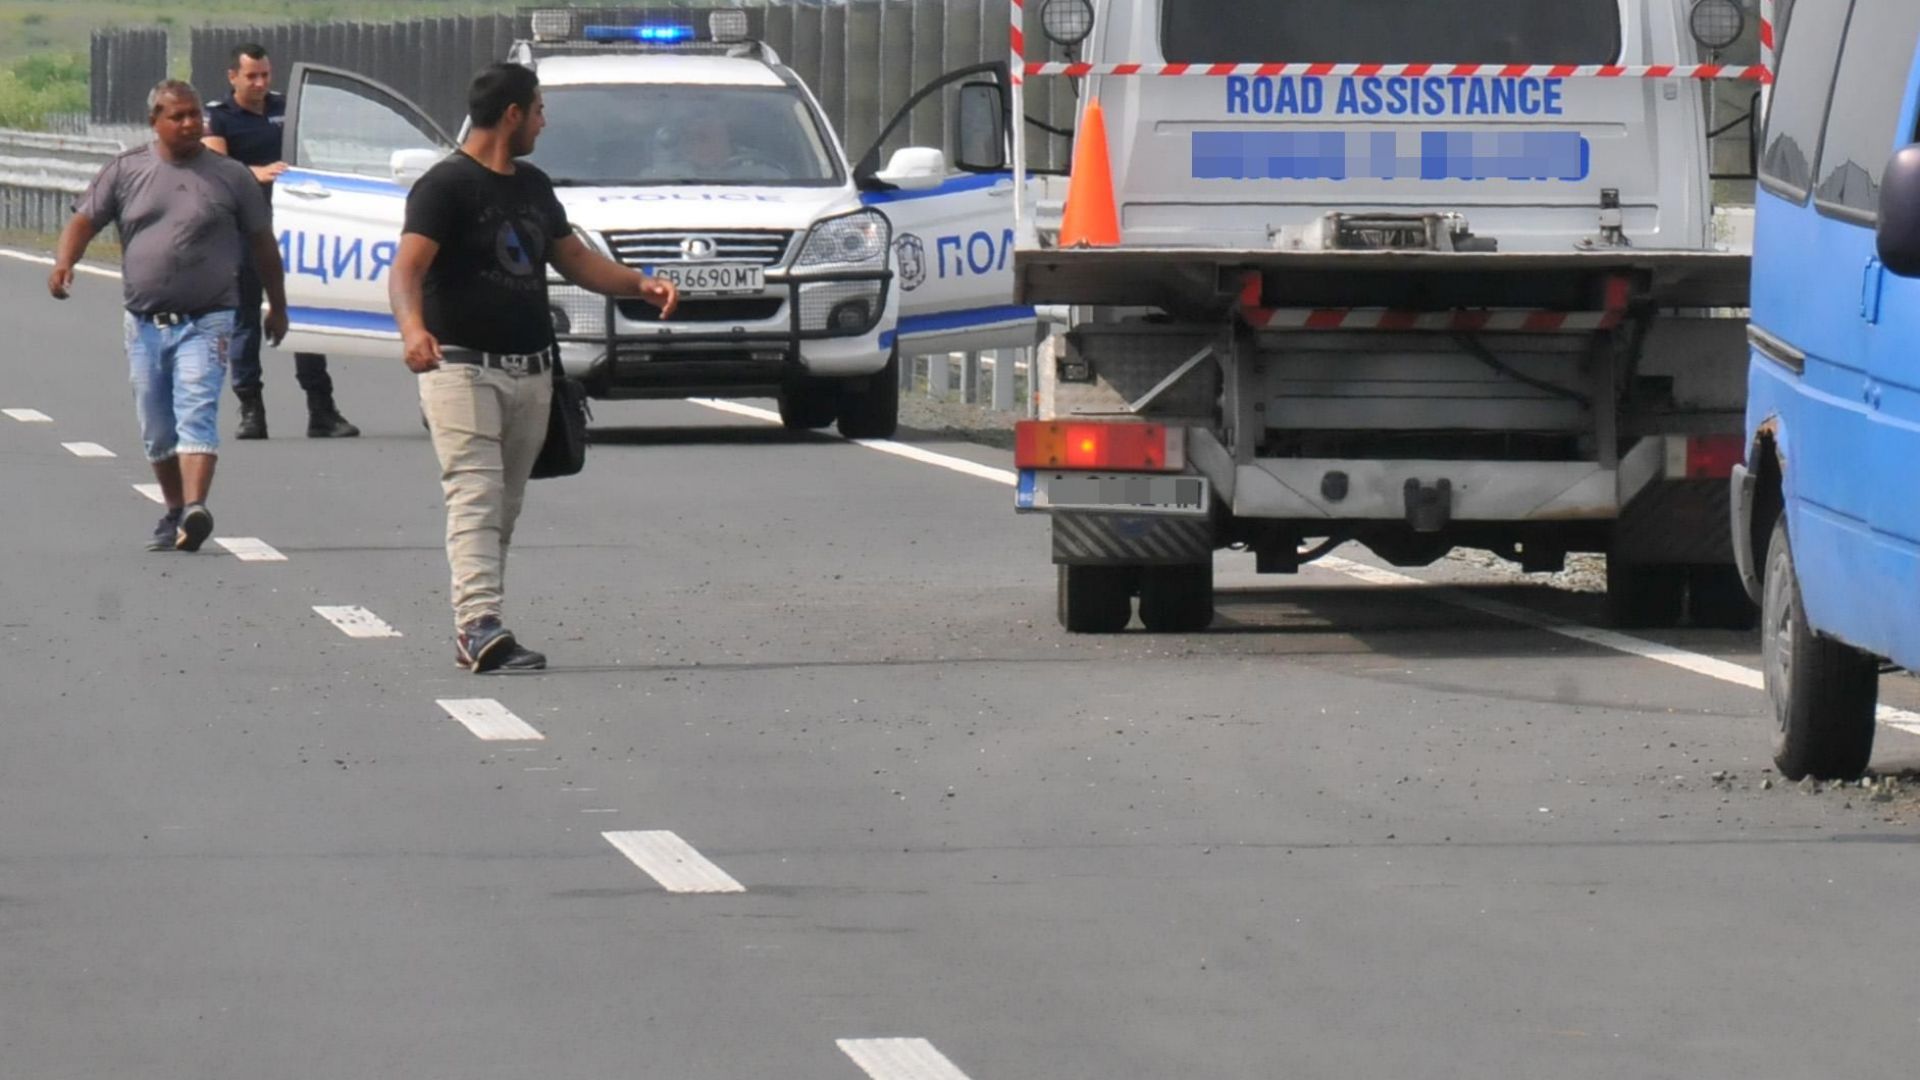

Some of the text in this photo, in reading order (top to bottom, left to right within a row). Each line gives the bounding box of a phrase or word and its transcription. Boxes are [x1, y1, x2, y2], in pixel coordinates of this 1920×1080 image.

[1226, 75, 1563, 115] ROAD ASSISTANCE
[598, 192, 786, 203] POLICE
